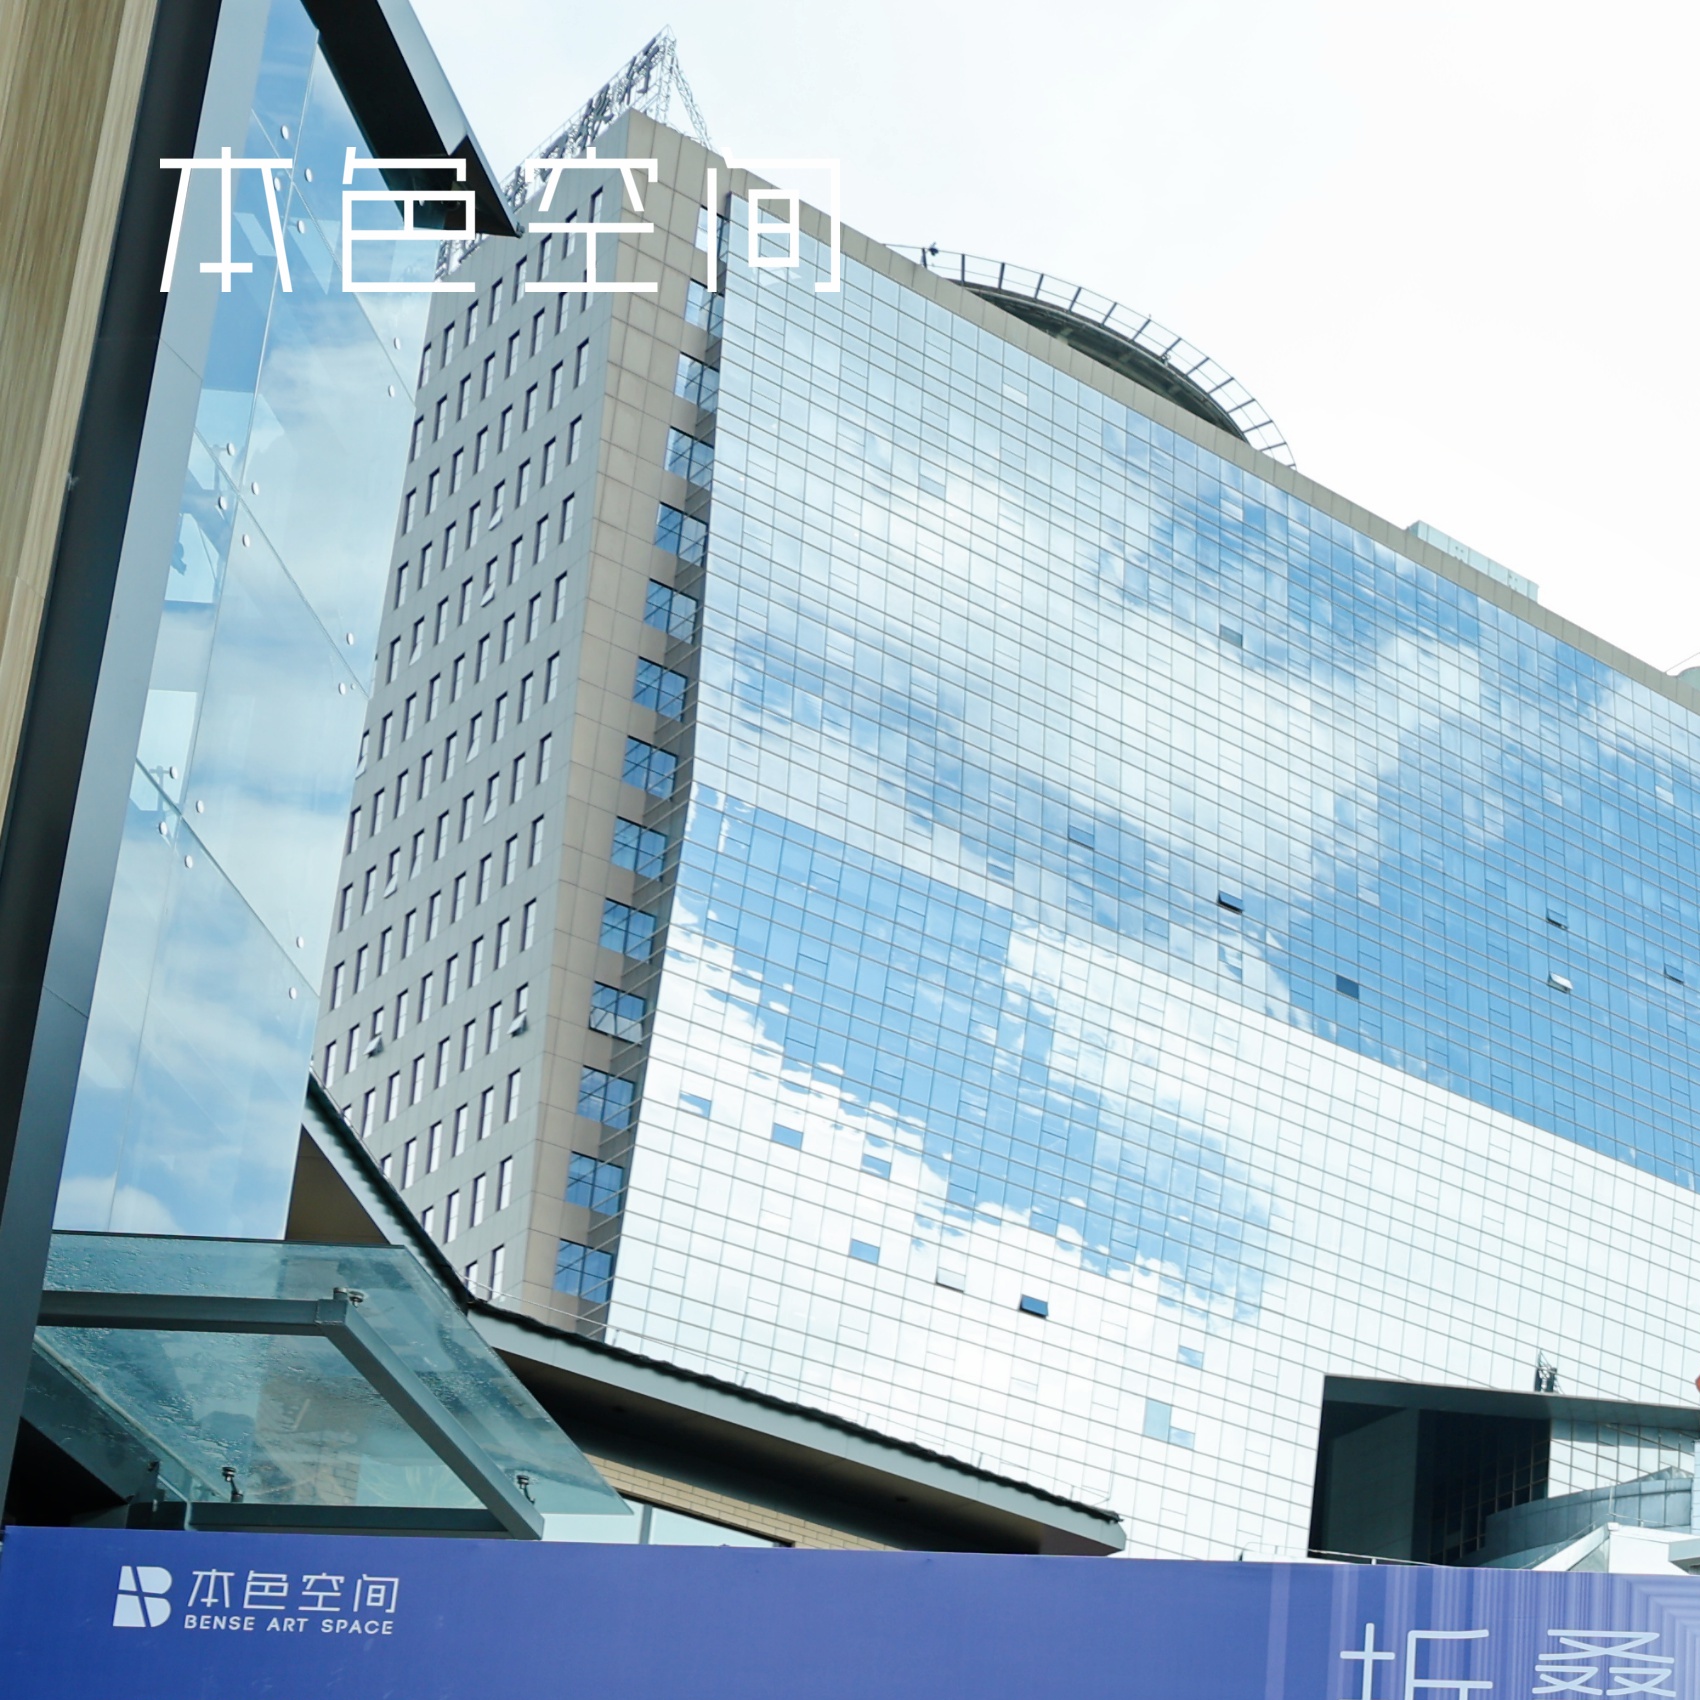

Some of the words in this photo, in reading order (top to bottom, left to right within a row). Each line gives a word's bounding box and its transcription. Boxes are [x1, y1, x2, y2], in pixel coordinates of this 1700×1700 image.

[188, 1569, 399, 1613] 本色空间
[185, 1615, 255, 1631] BENSE
[267, 1618, 308, 1632] ART
[321, 1619, 393, 1634] SPACE
